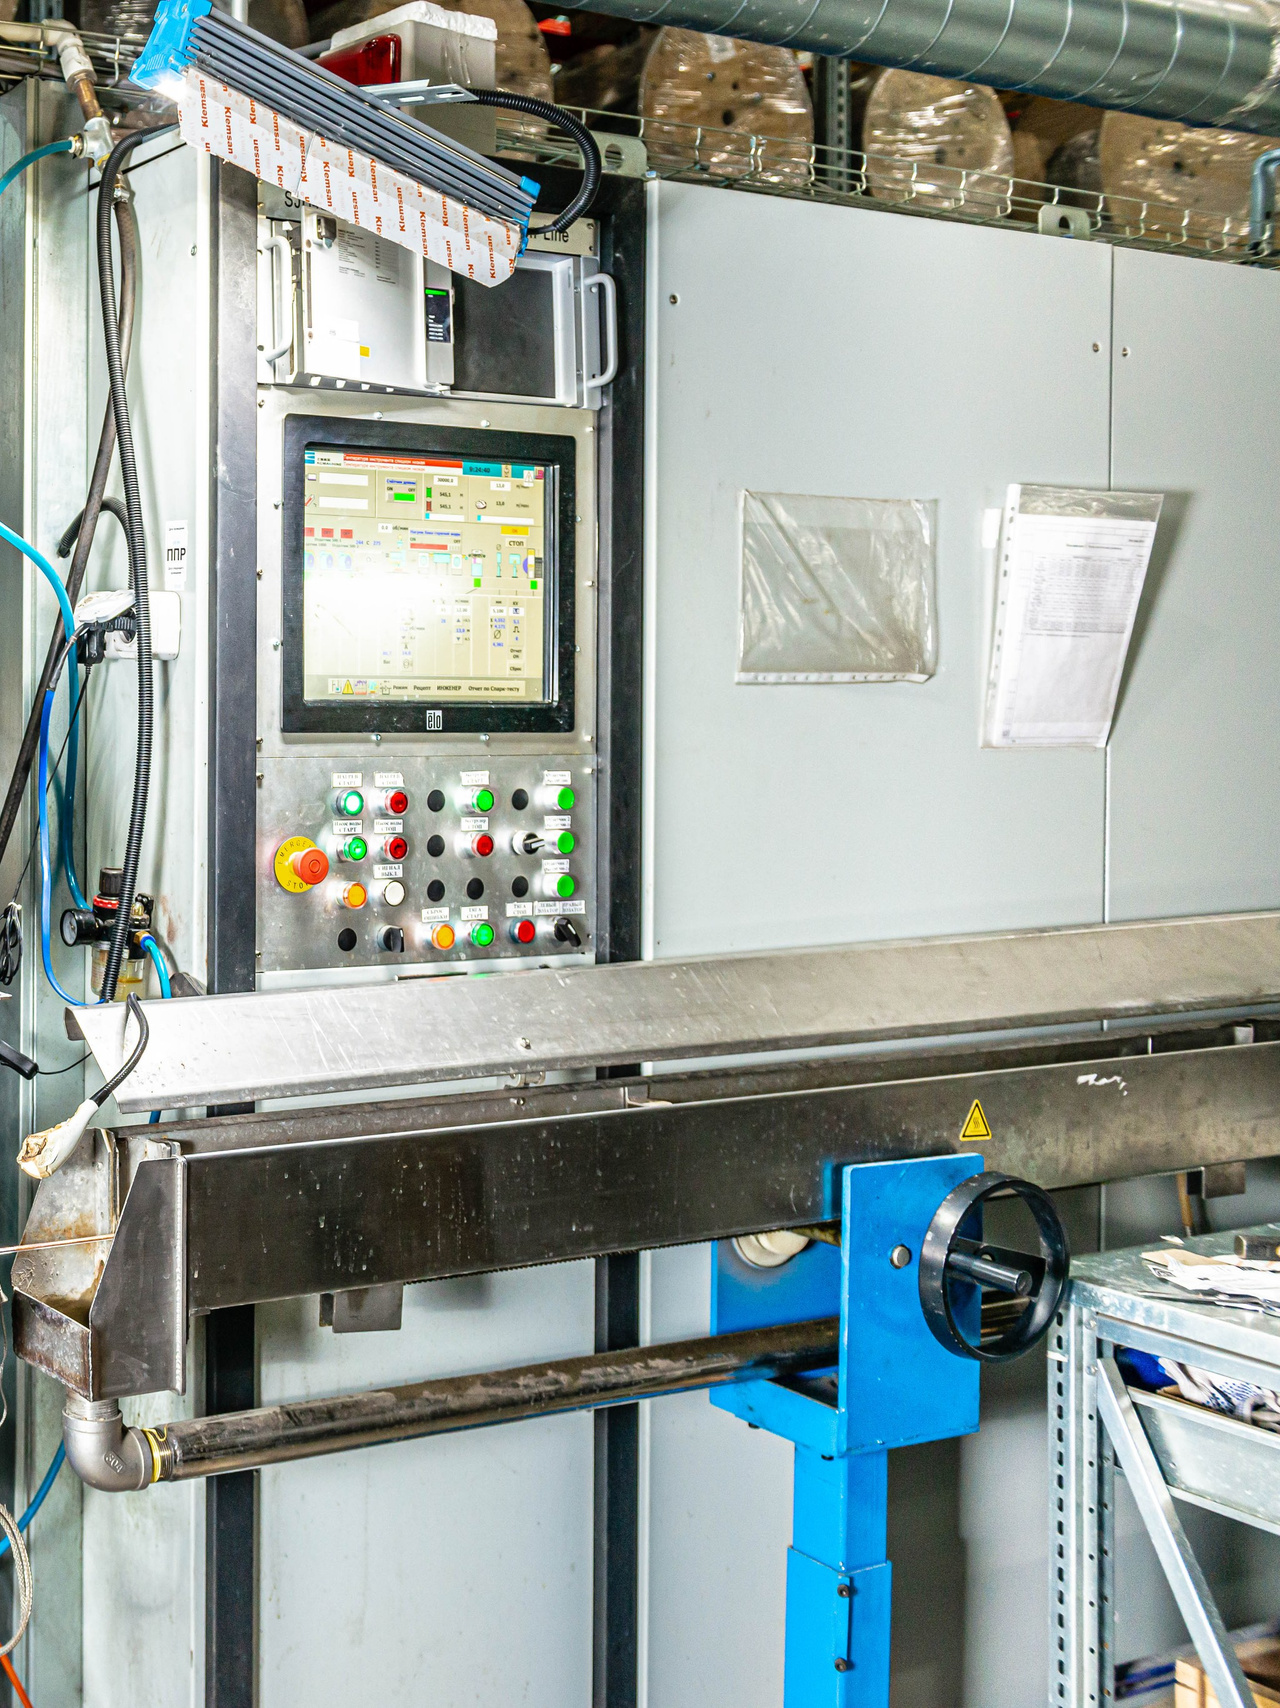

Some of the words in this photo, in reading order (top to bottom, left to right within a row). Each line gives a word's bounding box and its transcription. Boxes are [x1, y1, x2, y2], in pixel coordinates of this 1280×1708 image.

[199, 79, 209, 128] Klemsan
[224, 106, 233, 154] Klemsan
[299, 136, 308, 182] Klemsan
[370, 158, 379, 202] Klemsan
[323, 161, 333, 207] Klemsan
[397, 187, 406, 232] Klemsan
[462, 205, 471, 250] Klemsan
[420, 211, 429, 256] Klemsan
[487, 235, 496, 279] Klemsan
[167, 548, 186, 561] ППР
